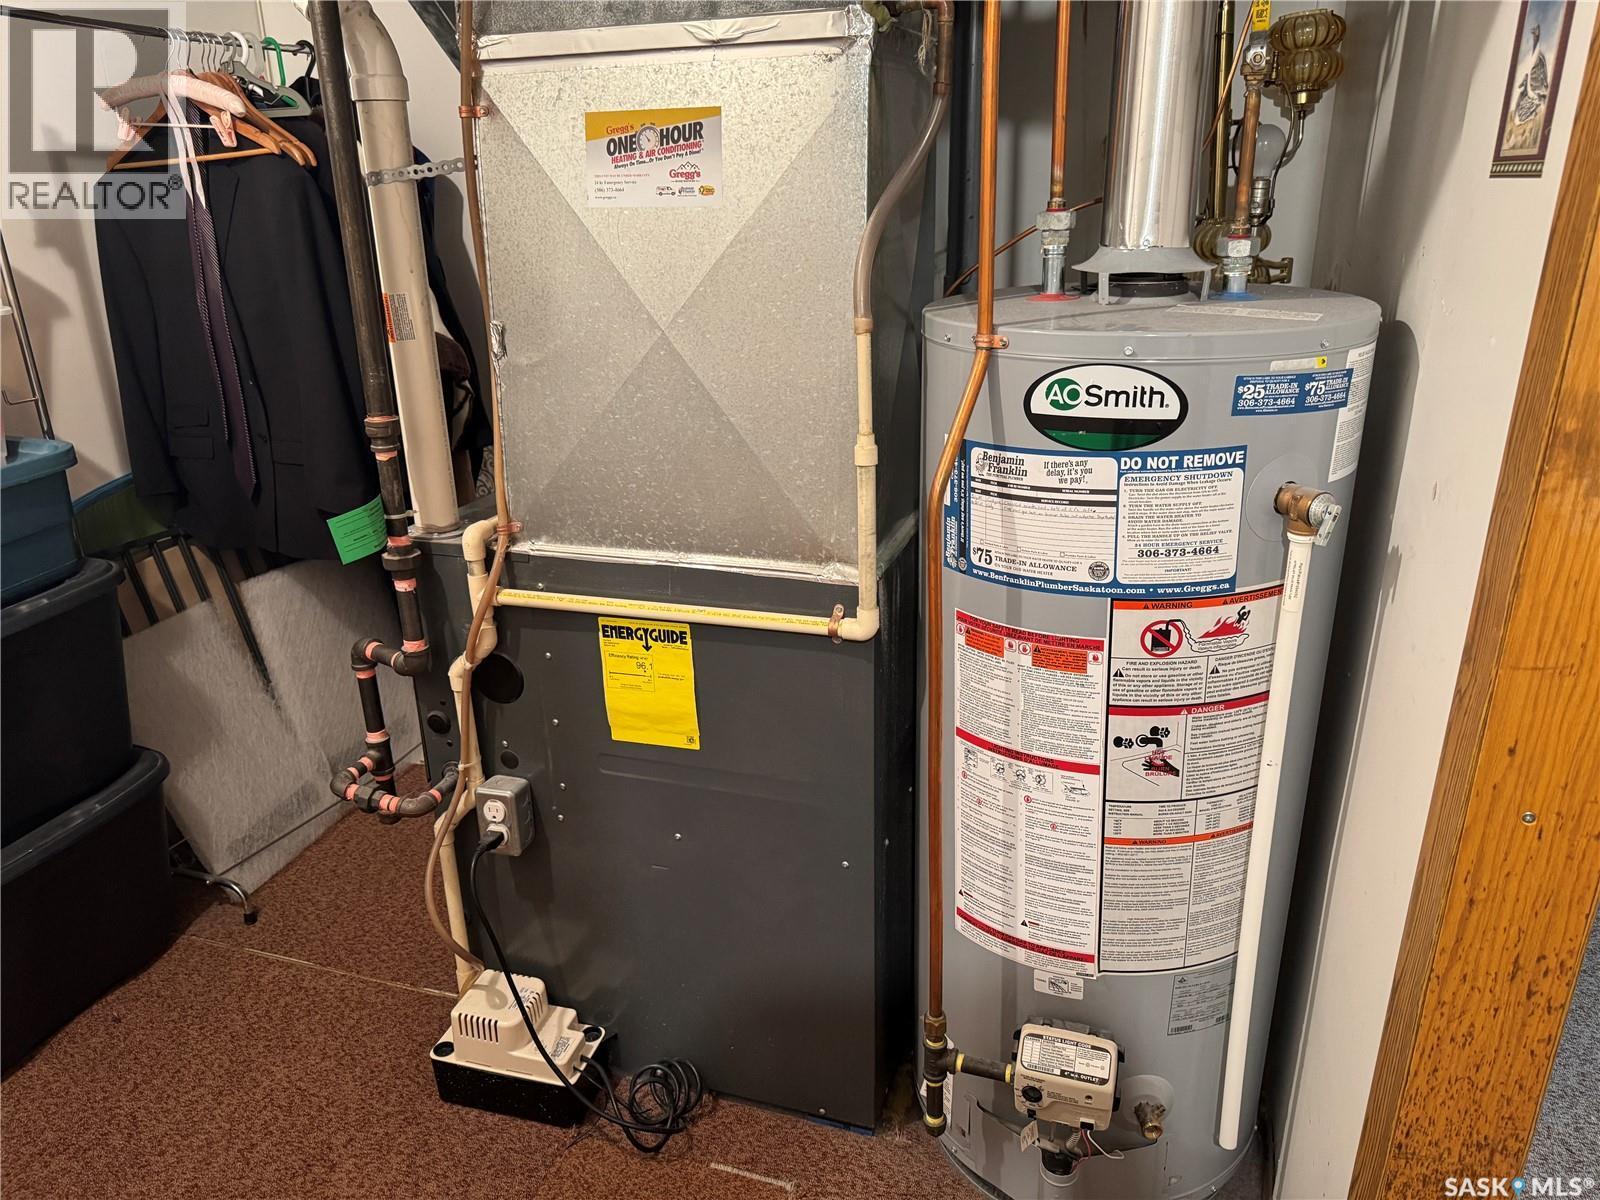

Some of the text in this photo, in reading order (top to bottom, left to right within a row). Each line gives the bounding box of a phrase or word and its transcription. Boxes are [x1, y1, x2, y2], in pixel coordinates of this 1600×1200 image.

[606, 122, 634, 135] Gregg's
[606, 121, 704, 156] ONE HOUR
[611, 153, 637, 164] HEATING
[645, 150, 656, 158] AIR
[657, 141, 702, 155] CONDITIONING
[669, 169, 701, 180] Gregg's
[1237, 384, 1265, 399] $25
[1266, 382, 1298, 390] TRADE-IN
[1304, 380, 1326, 396] $75
[1237, 397, 1296, 407] 306-373-4664
[982, 451, 1025, 466] Benjamin
[1044, 460, 1088, 469] If there's any
[1120, 457, 1142, 470] DO
[1147, 456, 1179, 469] NOT
[1183, 450, 1245, 469] REMOVE
[987, 462, 1028, 477] Franklin
[1046, 469, 1066, 477] delay,
[1079, 468, 1093, 476] you
[1124, 471, 1233, 483] EMERGENCY SHUTDOWN
[972, 547, 993, 565] $75
[1137, 546, 1219, 558] 306-373-4664
[994, 556, 1027, 567] TRADE-IN
[1029, 562, 1078, 572] ALLOWANCE
[1157, 582, 1230, 594] www.Greggs.ca
[1151, 602, 1193, 610] WARNING
[601, 624, 688, 646] ENERGYGUIDE
[1027, 630, 1049, 639] BEFORE
[1051, 634, 1080, 643] LIGHTING
[636, 662, 653, 670] 96.1
[1191, 705, 1225, 713] DANGER
[1043, 1035, 1061, 1043] STATUS
[1081, 1074, 1100, 1082] OUTLET
